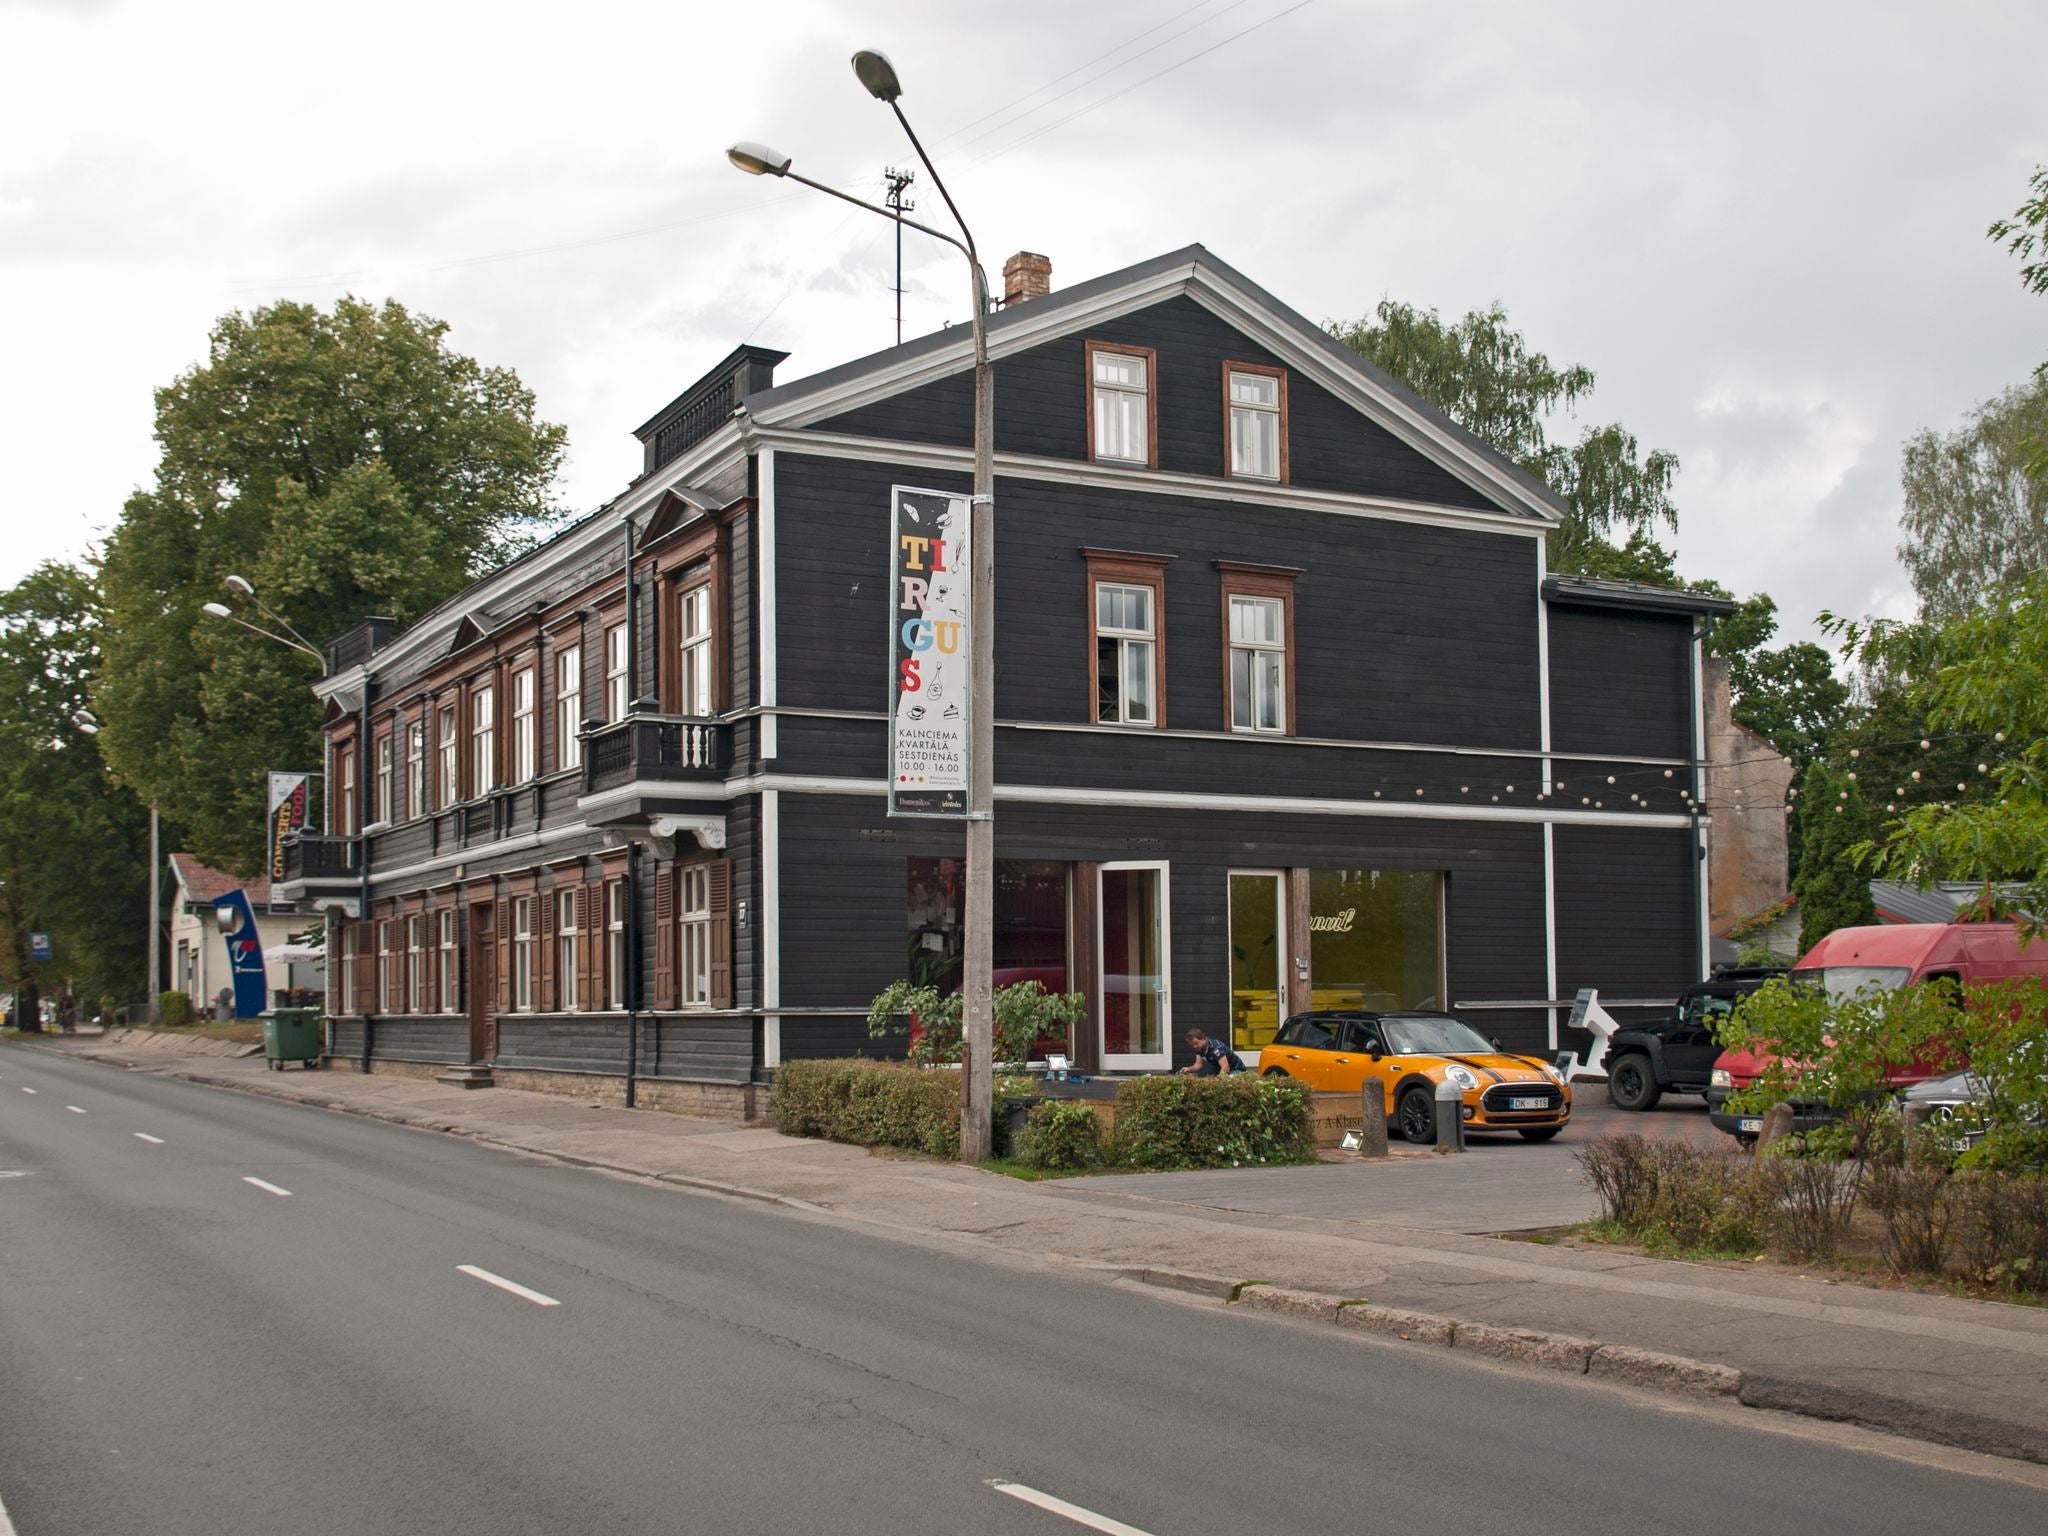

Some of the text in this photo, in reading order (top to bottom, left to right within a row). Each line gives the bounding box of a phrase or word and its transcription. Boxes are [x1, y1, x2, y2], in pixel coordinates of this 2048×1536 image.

[899, 729, 958, 740] KALNCIEMA
[899, 739, 949, 751] KVARTĀLĀ
[899, 751, 959, 762] SESTDIENĀS
[900, 762, 925, 771] 10.00
[934, 763, 959, 773] 16.00
[291, 784, 305, 825] FOOD
